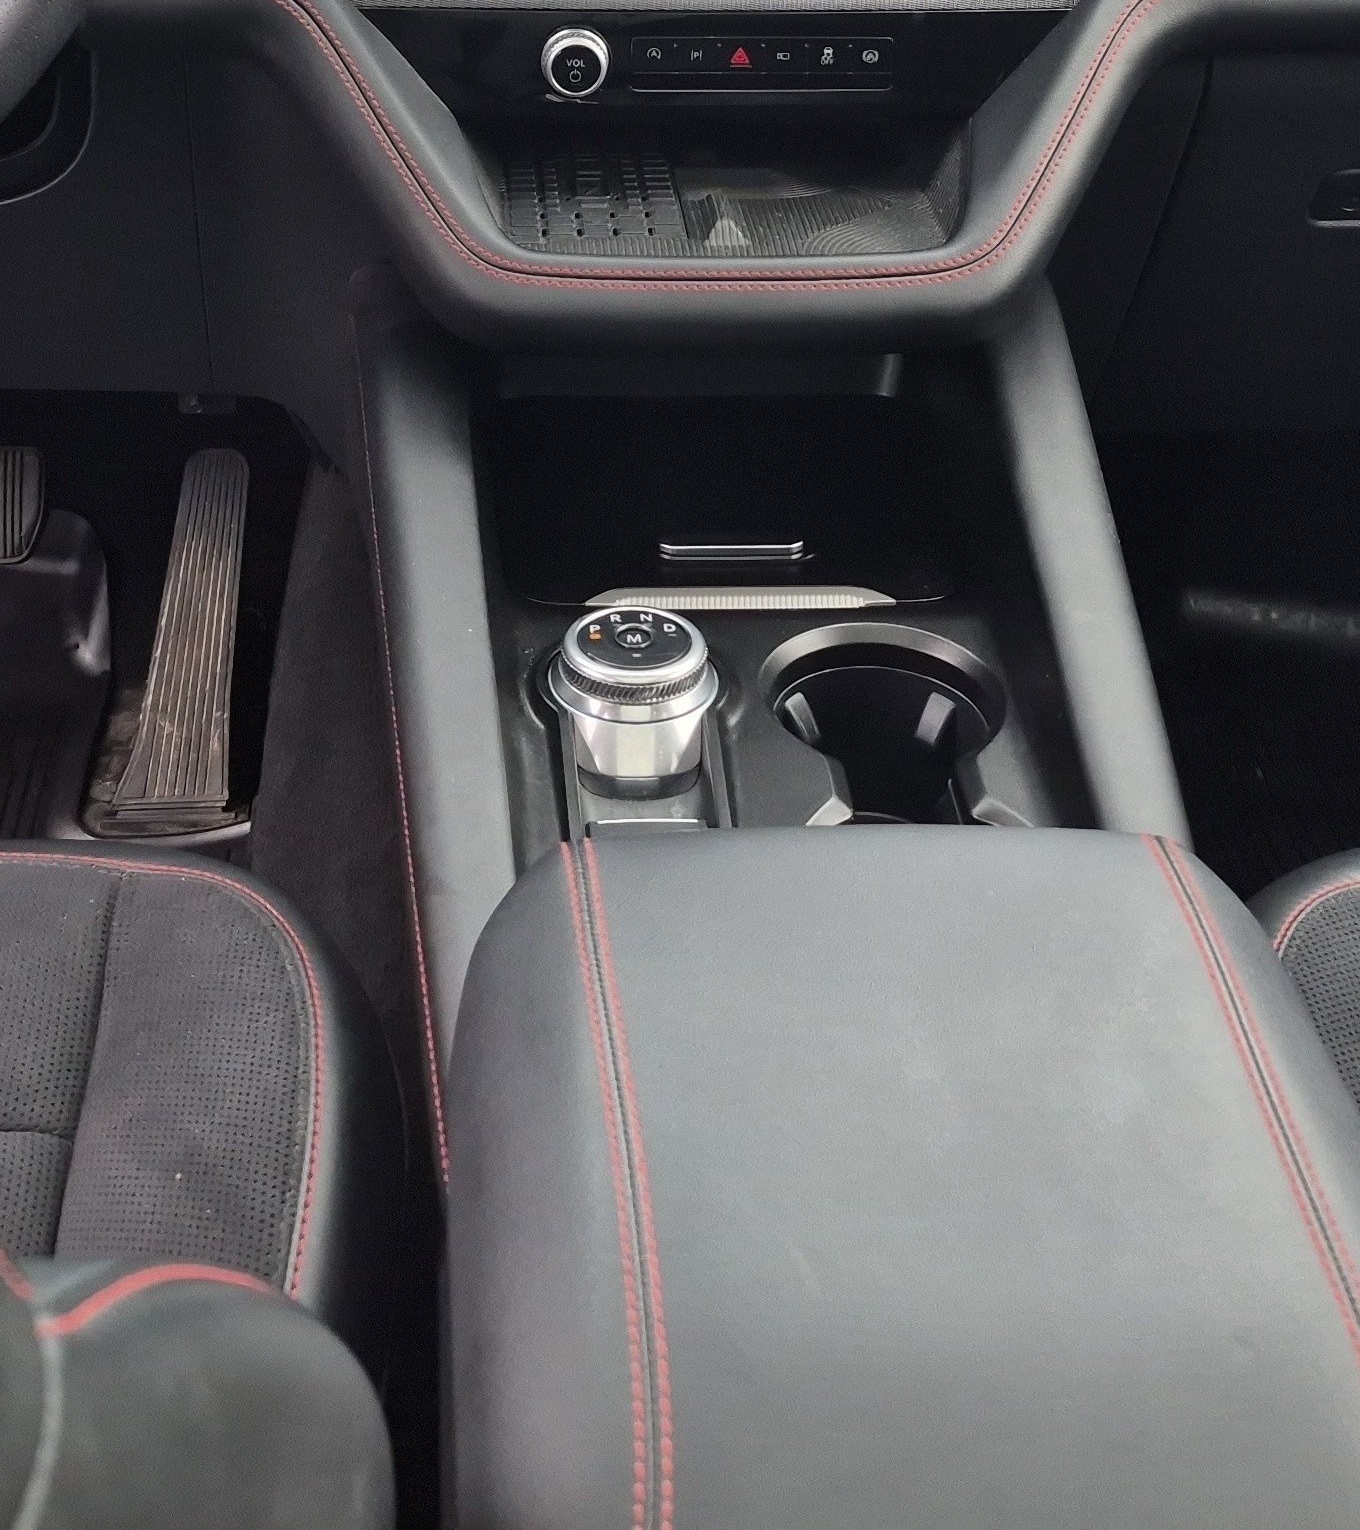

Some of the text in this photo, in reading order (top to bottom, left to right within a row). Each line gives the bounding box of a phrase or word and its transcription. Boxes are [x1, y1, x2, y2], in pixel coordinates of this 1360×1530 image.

[565, 58, 586, 68] VOL
[609, 613, 654, 623] R N
[589, 622, 677, 644] P M D
